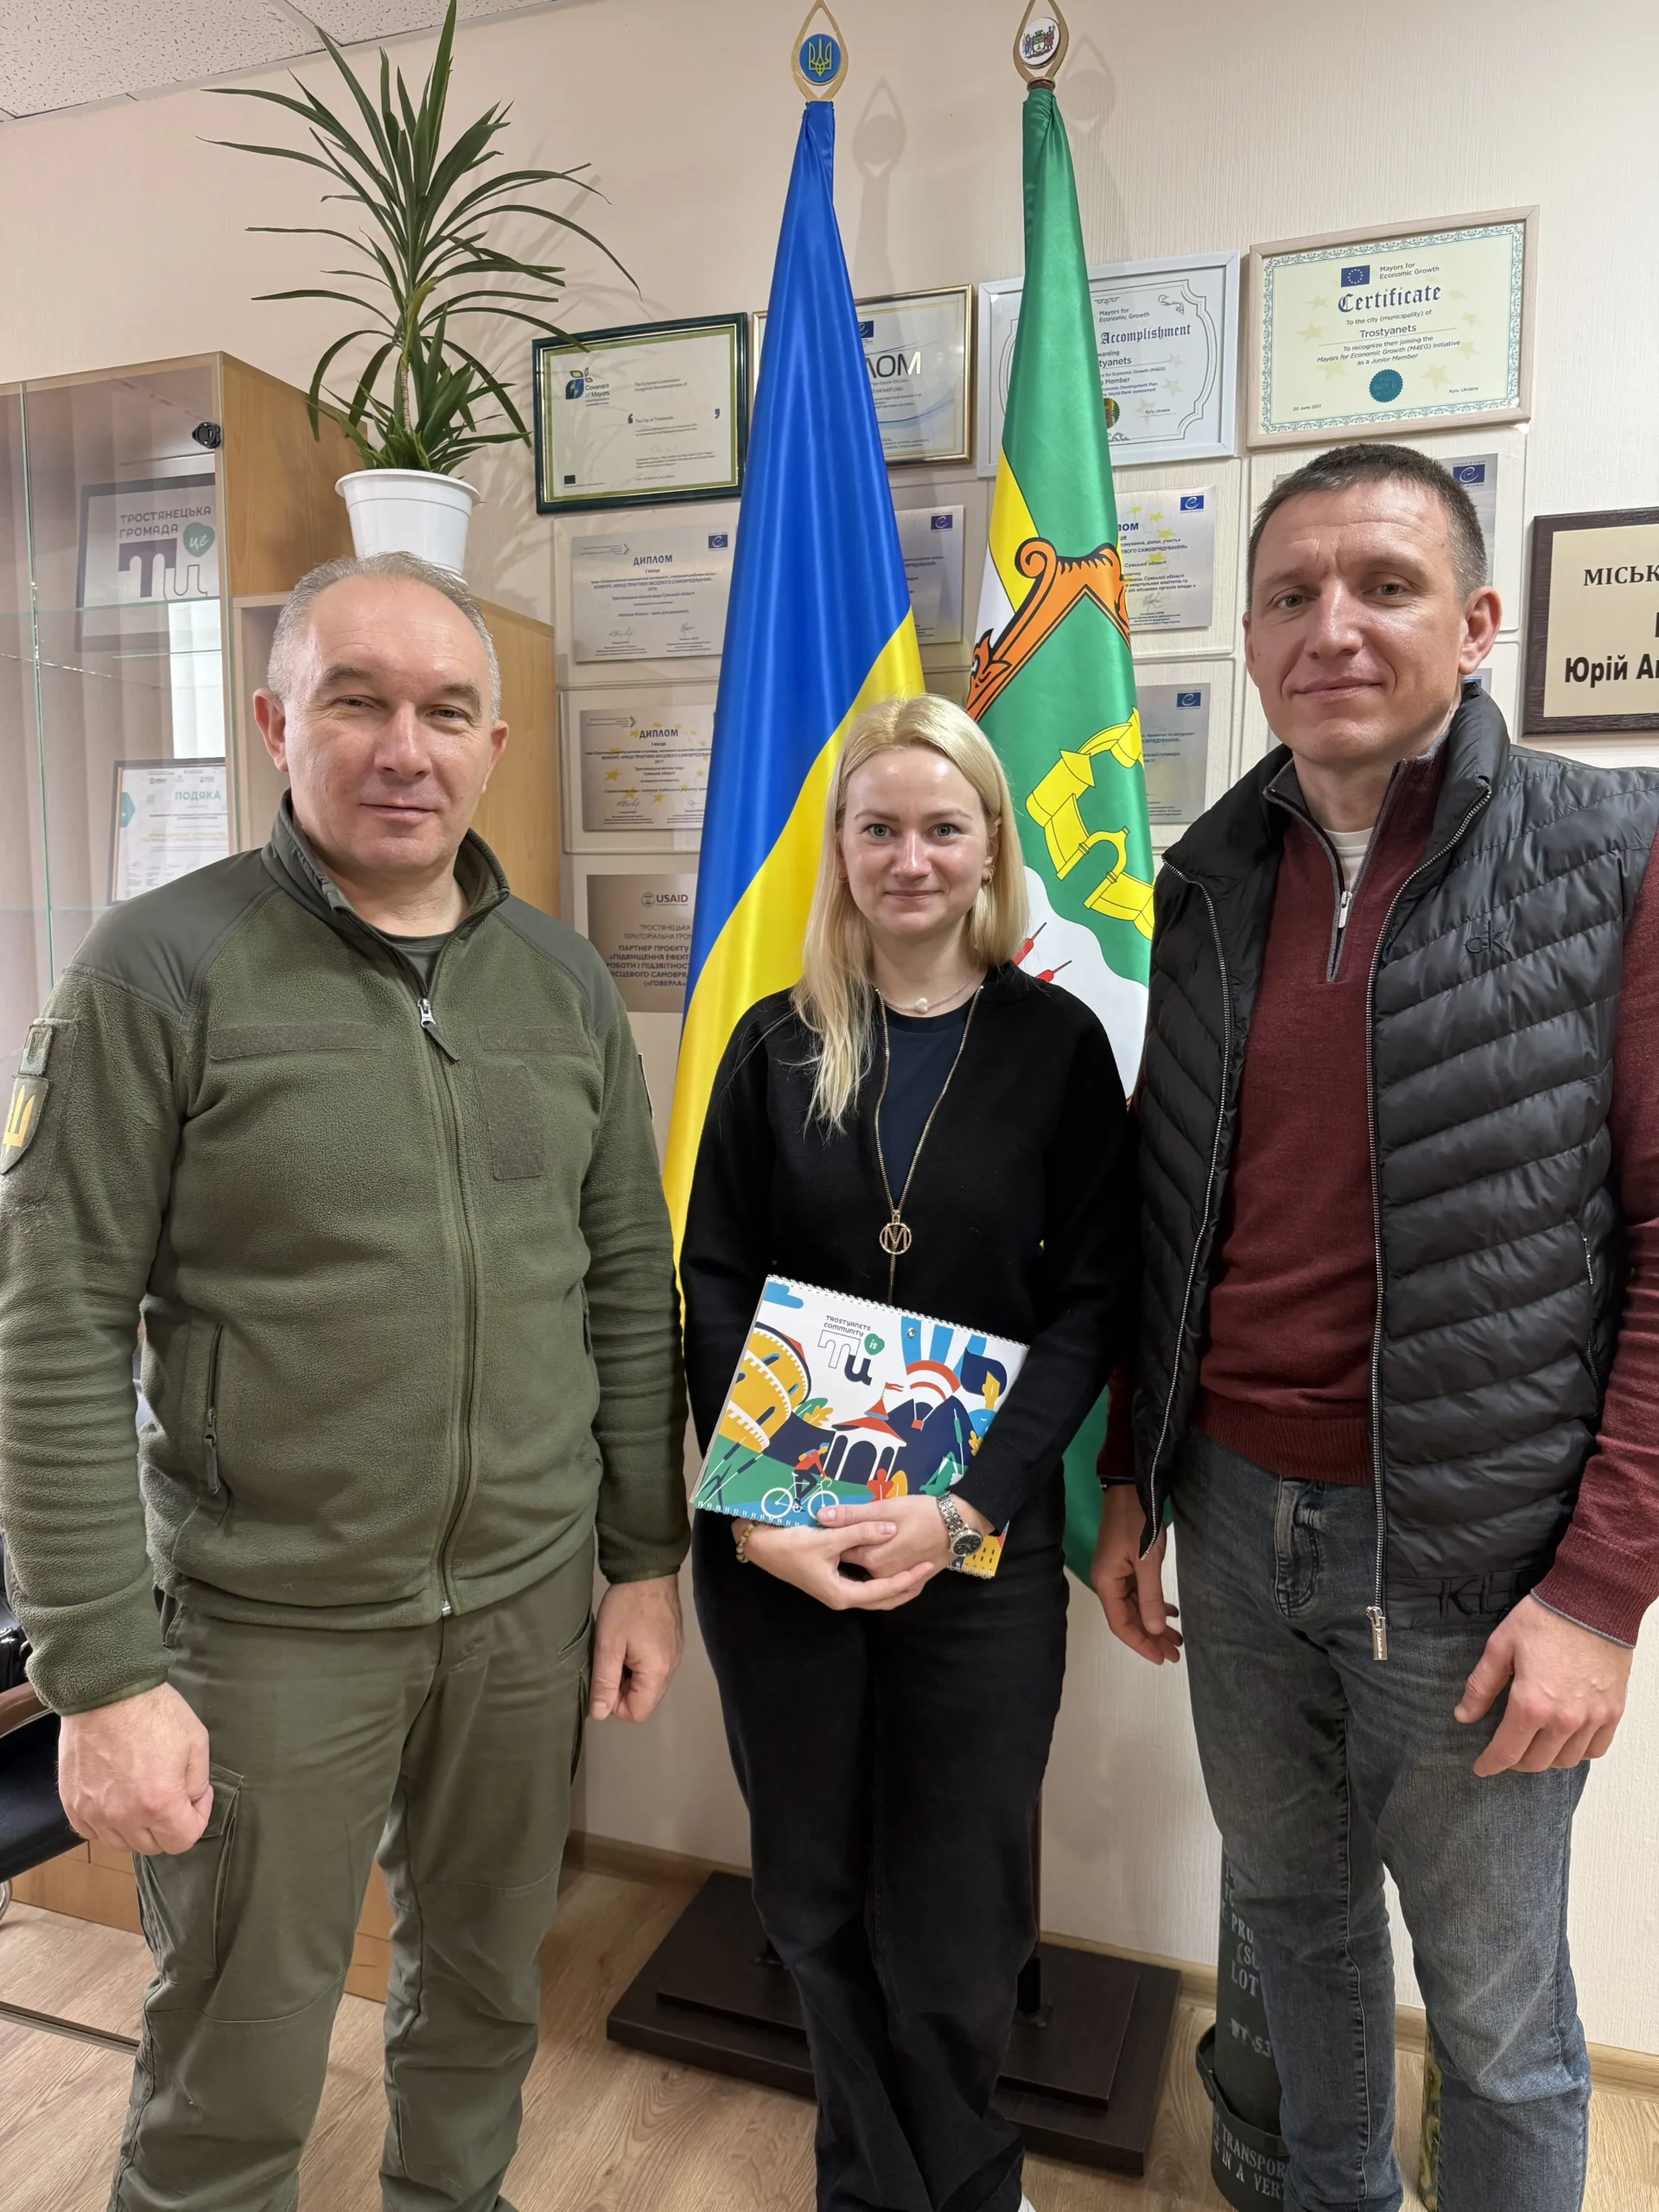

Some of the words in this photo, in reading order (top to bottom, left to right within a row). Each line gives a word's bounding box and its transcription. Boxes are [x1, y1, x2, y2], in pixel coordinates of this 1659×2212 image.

[1380, 264, 1403, 273] Mayors
[1380, 270, 1413, 279] Economic
[1414, 266, 1440, 275] Growth
[1338, 284, 1441, 313] Certificate
[1128, 311, 1150, 320] Growth
[1380, 310, 1424, 322] (municipality)
[1100, 323, 1192, 345] Accomplishment
[1359, 324, 1417, 339] Trostyanets
[1351, 342, 1382, 352] recognize
[1399, 337, 1421, 346] joining
[1350, 350, 1381, 359] Economic
[1391, 353, 1418, 362] Member
[1099, 357, 1132, 369] tyanets
[120, 506, 211, 524] ТРОСТЯНЕЦЬКА
[119, 524, 178, 537] ГРОМАДА
[189, 535, 209, 550] це
[633, 555, 672, 566] ДИПЛОМ
[1583, 564, 1659, 587] МІСЬК
[1565, 654, 1628, 689] Юрій
[639, 729, 678, 739] ДИПЛОМ
[175, 791, 221, 801] ПОДЯКА
[657, 894, 688, 903] USAID
[869, 1338, 878, 1350] is
[1222, 2122, 1287, 2178] TRANSPOR
